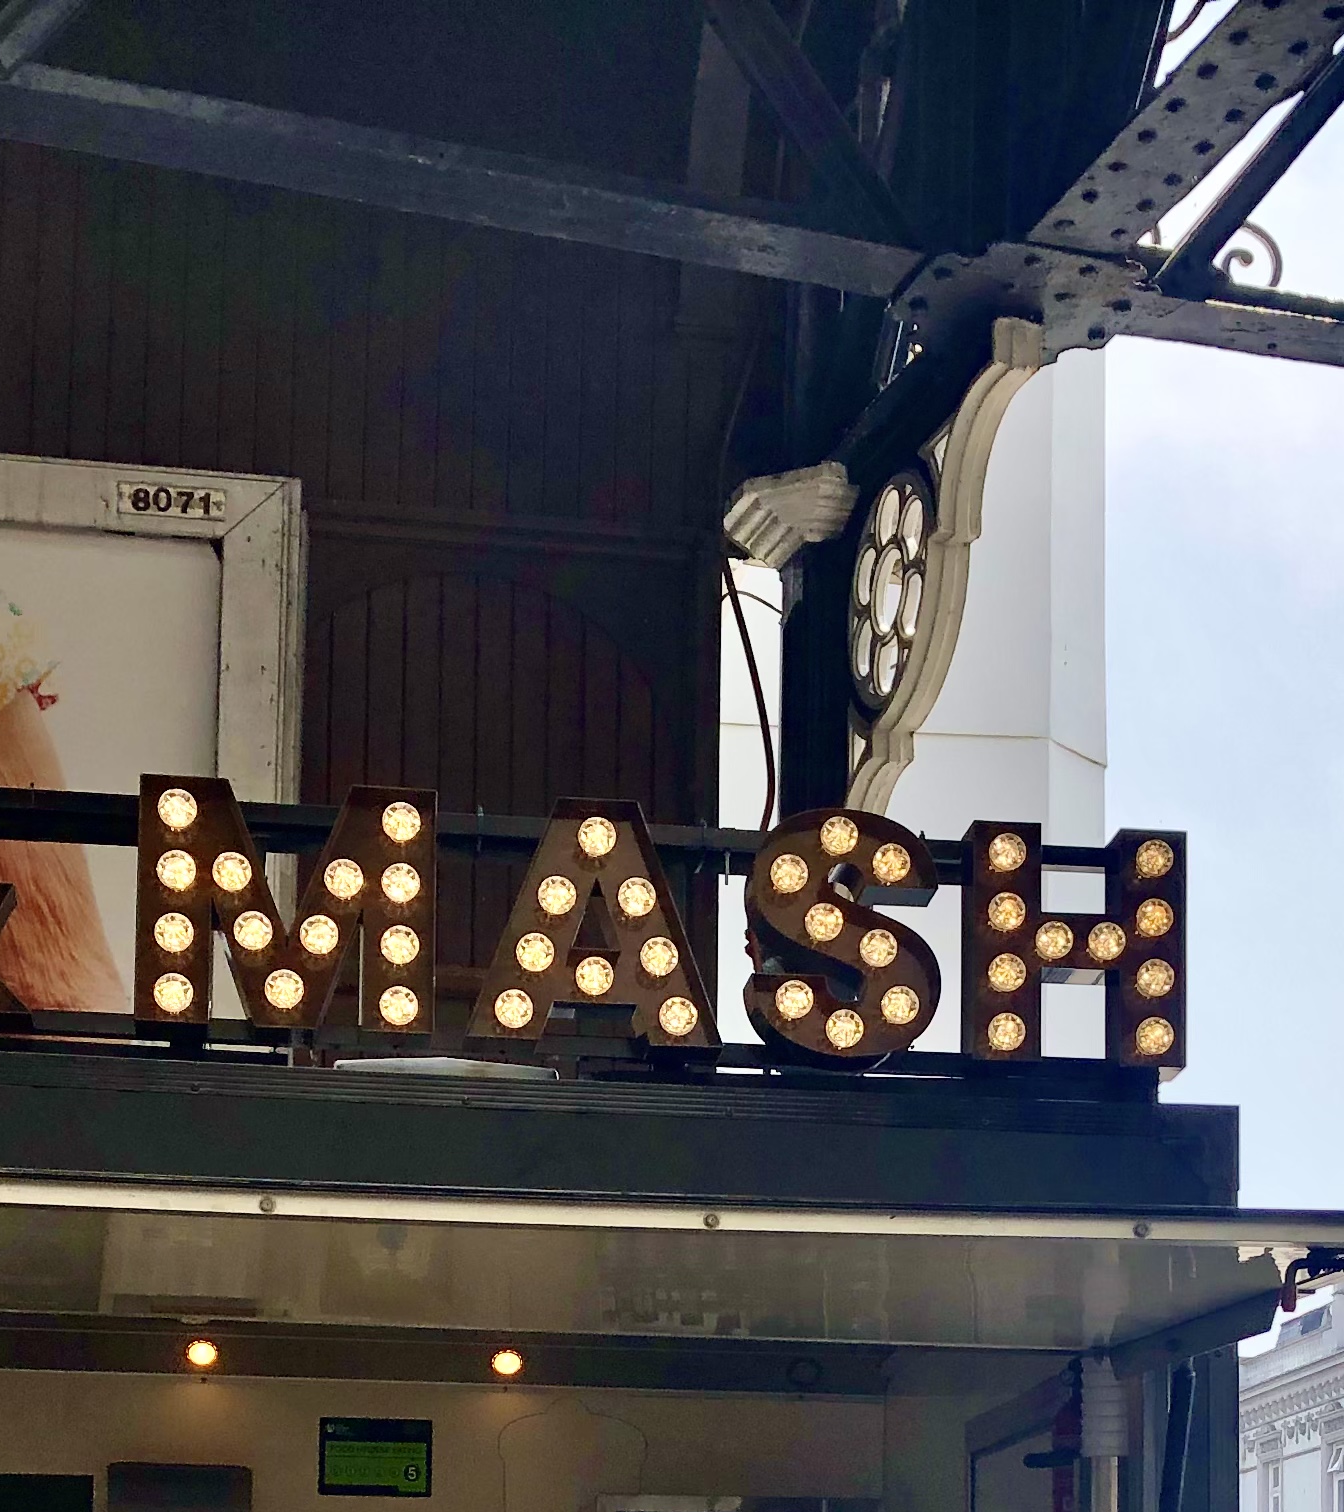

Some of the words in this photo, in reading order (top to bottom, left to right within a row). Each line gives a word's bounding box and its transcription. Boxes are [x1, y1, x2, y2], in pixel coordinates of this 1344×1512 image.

[131, 486, 211, 516] 8071
[135, 772, 1187, 1080] MASH
[407, 1466, 417, 1480] 5
